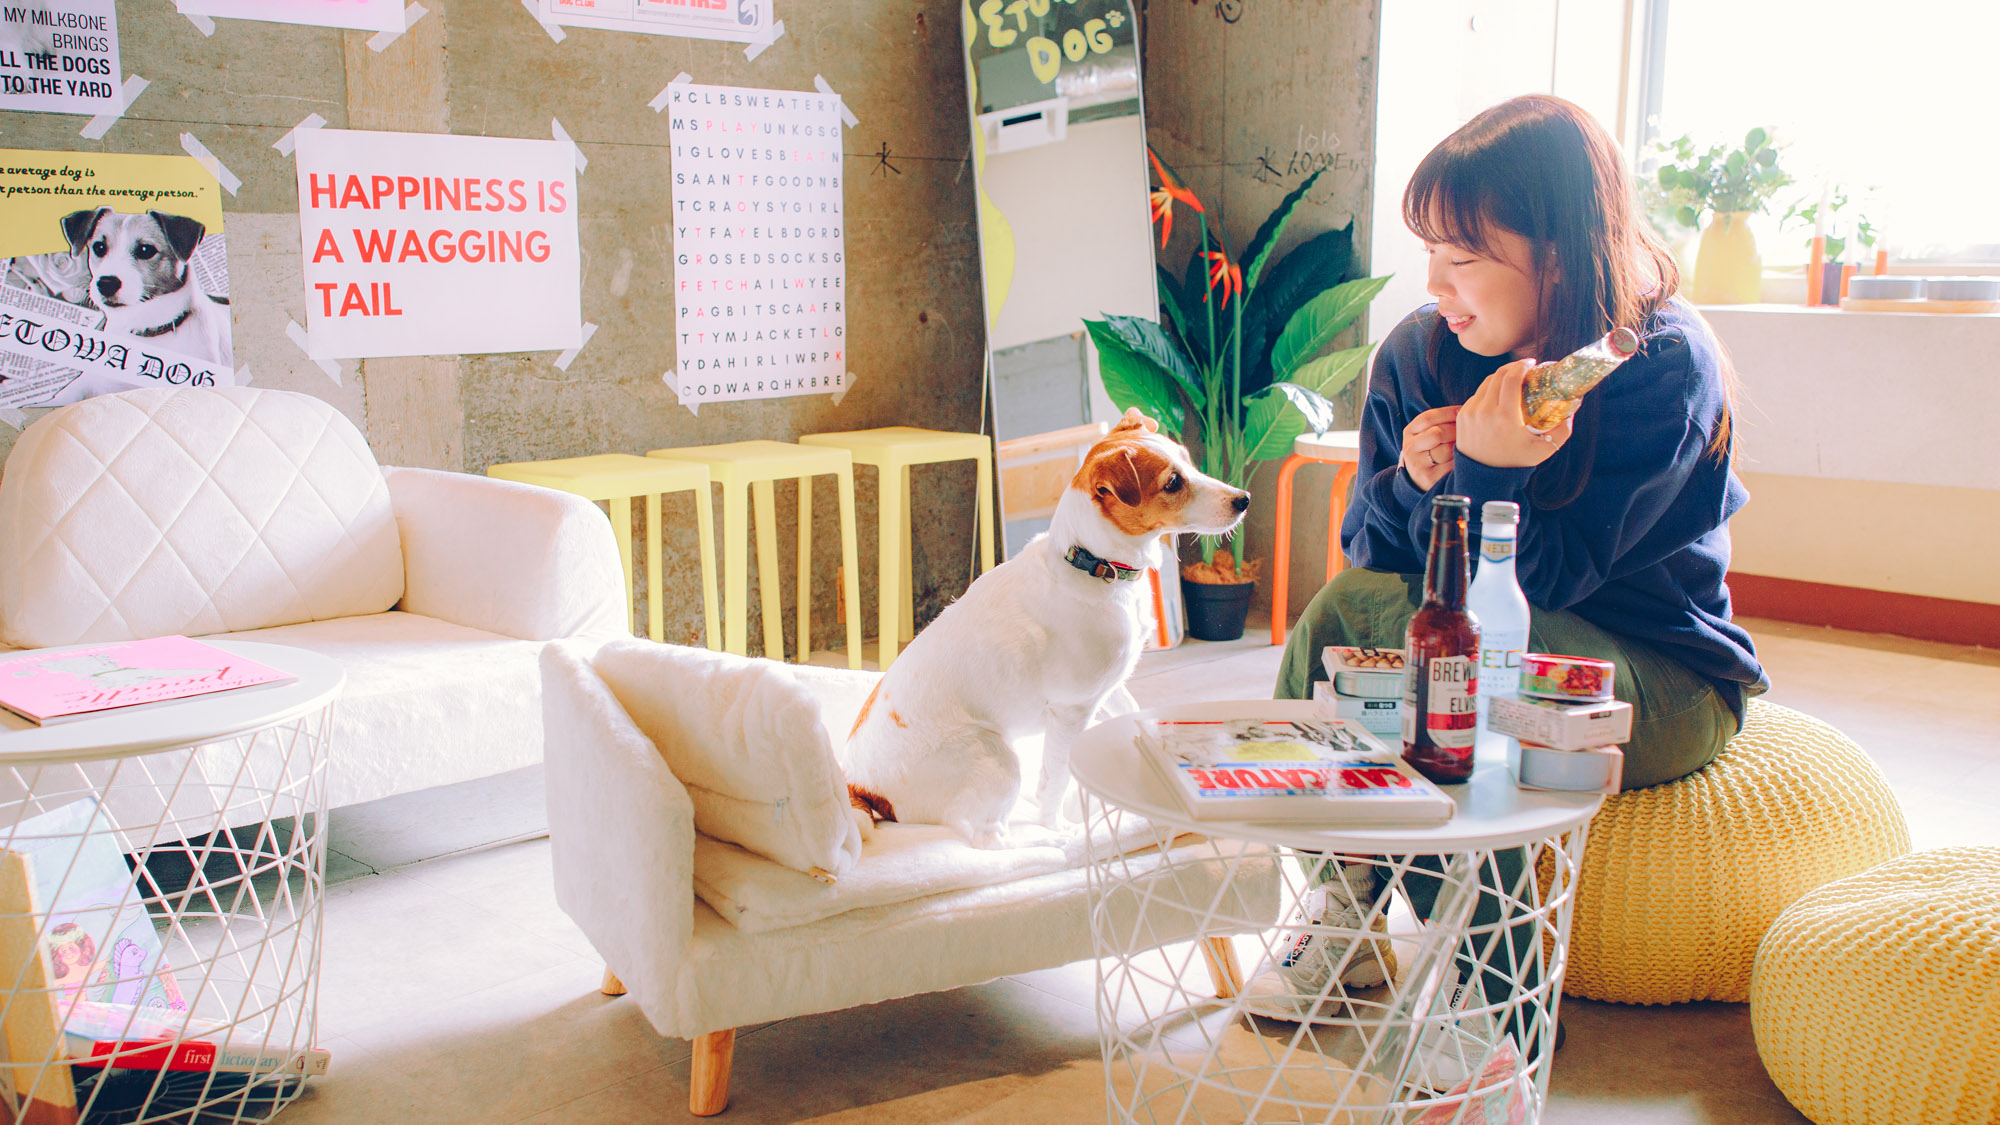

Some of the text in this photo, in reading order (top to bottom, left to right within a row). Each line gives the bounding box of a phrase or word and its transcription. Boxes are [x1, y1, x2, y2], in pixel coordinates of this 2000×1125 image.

[4, 6, 108, 31] MY MILKBONE
[53, 33, 109, 52] BRINGS
[1026, 18, 1114, 85] DOG
[0, 50, 111, 75] LL THE DOGS
[0, 75, 112, 98] TO THE YARD
[7, 167, 57, 180] average
[59, 165, 82, 181] dog
[84, 168, 95, 177] is
[6, 186, 52, 198] person
[54, 184, 84, 195] than
[86, 184, 106, 195] the
[108, 189, 155, 201] average
[309, 173, 567, 213] HAPPINESS IS
[312, 229, 551, 264] A WAGGING
[314, 282, 402, 317] TAIL
[137, 351, 216, 387] DOG
[1187, 768, 1413, 789] CARCATURE
[184, 1049, 212, 1065] first
